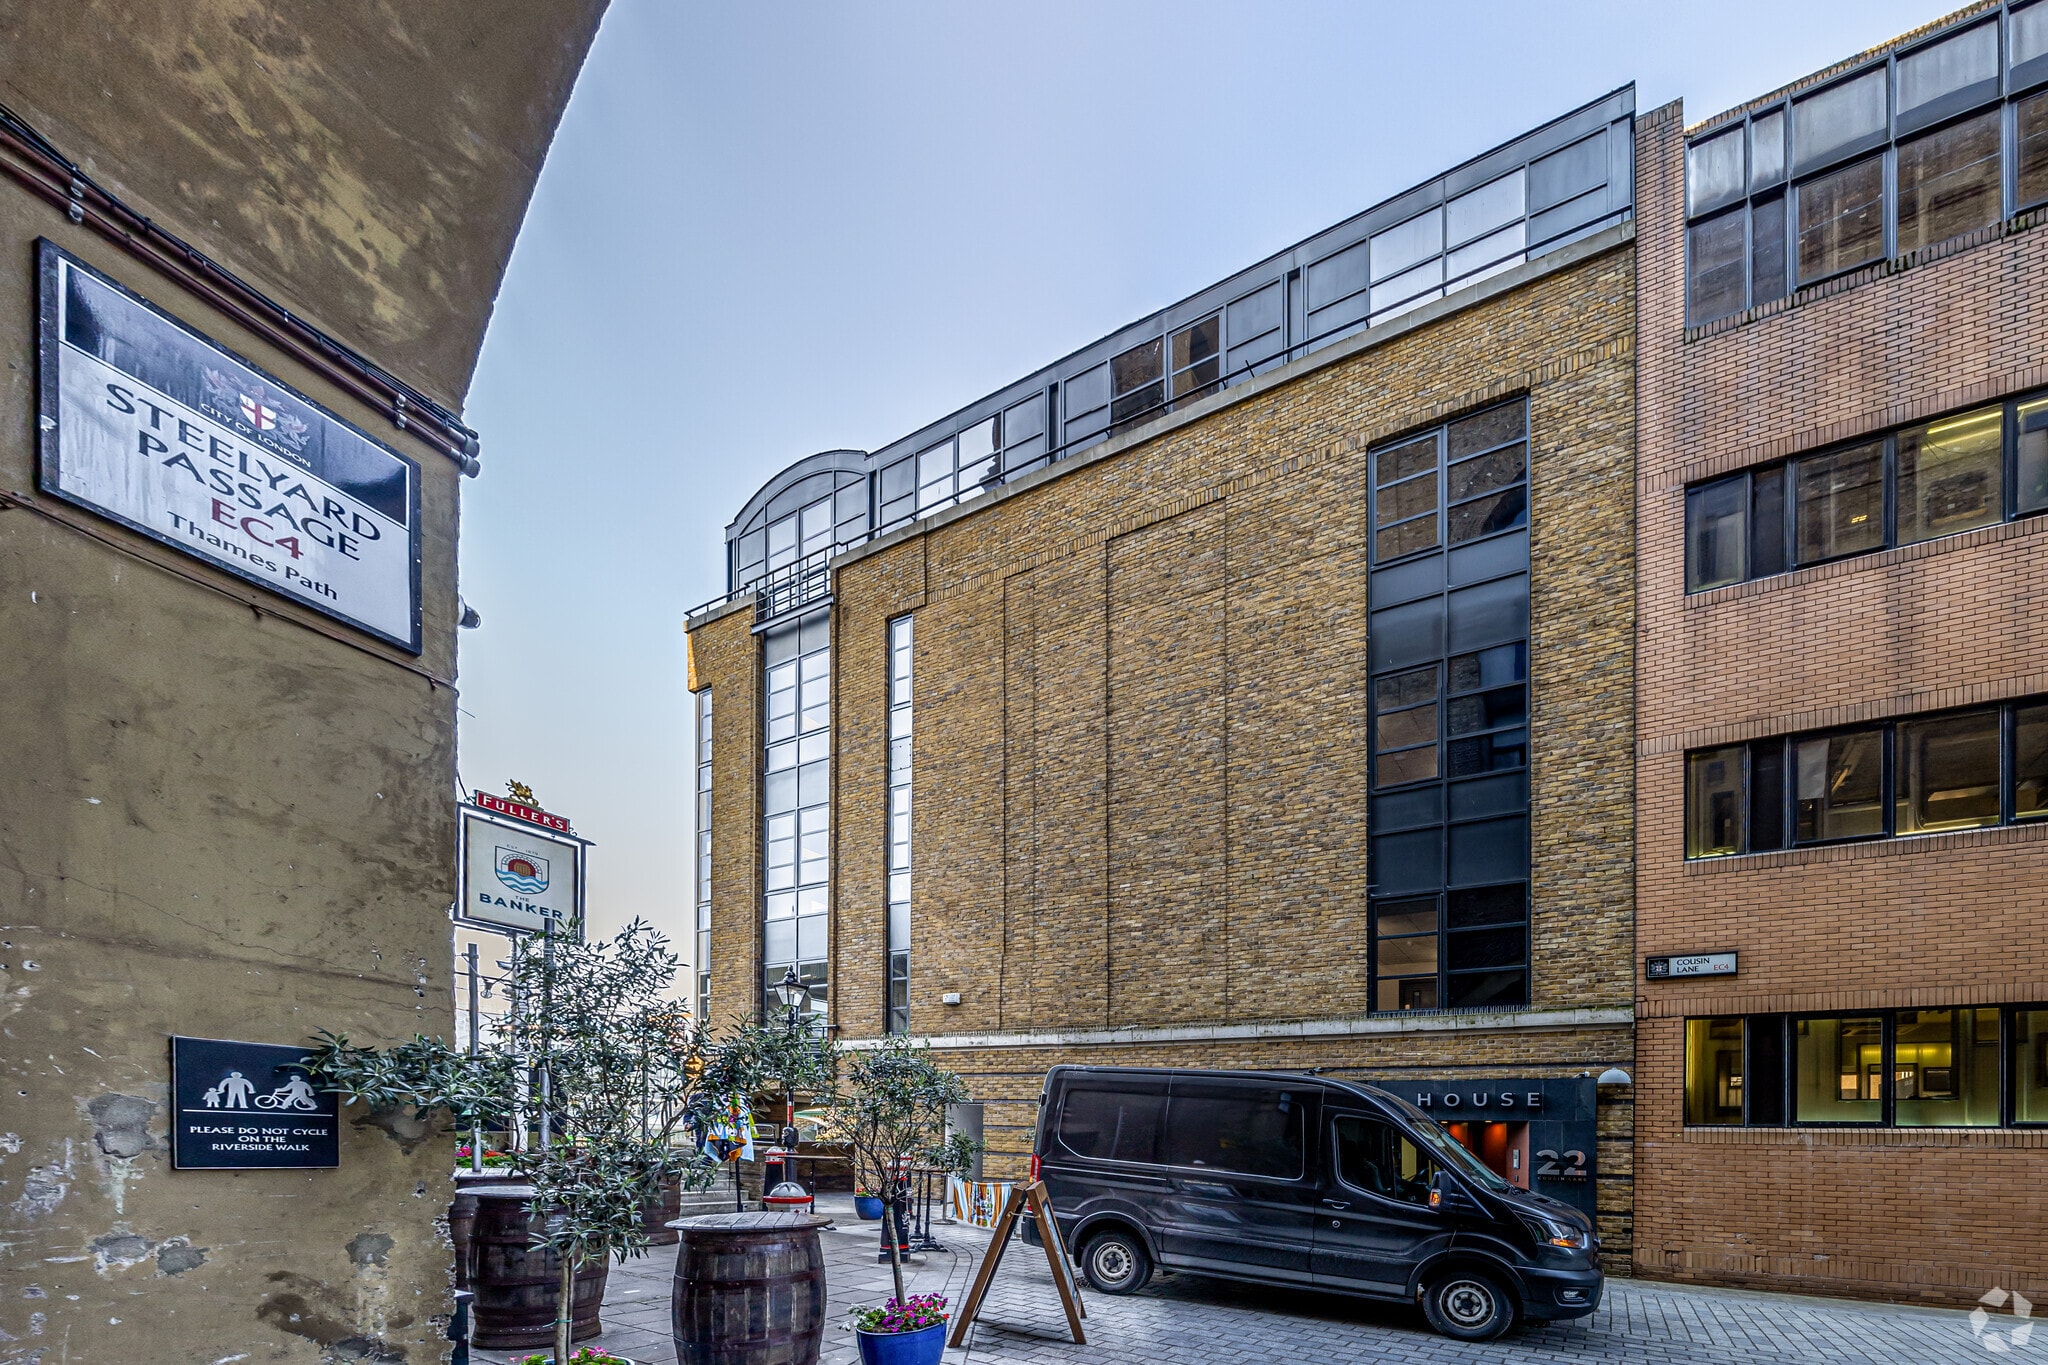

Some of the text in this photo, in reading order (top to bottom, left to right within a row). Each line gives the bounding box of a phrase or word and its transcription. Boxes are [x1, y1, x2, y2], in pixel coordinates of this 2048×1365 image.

[200, 402, 312, 469] CITY OF LONDON
[106, 382, 381, 542] STEELYARD
[138, 430, 361, 561] PASSAGE
[211, 497, 304, 560] EC4
[168, 510, 338, 601] Thames Path
[483, 794, 564, 830] FULLER'S
[479, 892, 563, 920] BANKER
[1676, 957, 1710, 966] COUSIN
[1713, 963, 1729, 971] EC4
[1417, 1092, 1541, 1107] HOUSE
[190, 1126, 328, 1136] PLEASE DO NOT CYCLE
[238, 1135, 286, 1143] ON THE
[212, 1143, 310, 1151] RIVERSIDE WALK
[1536, 1149, 1587, 1176] 22
